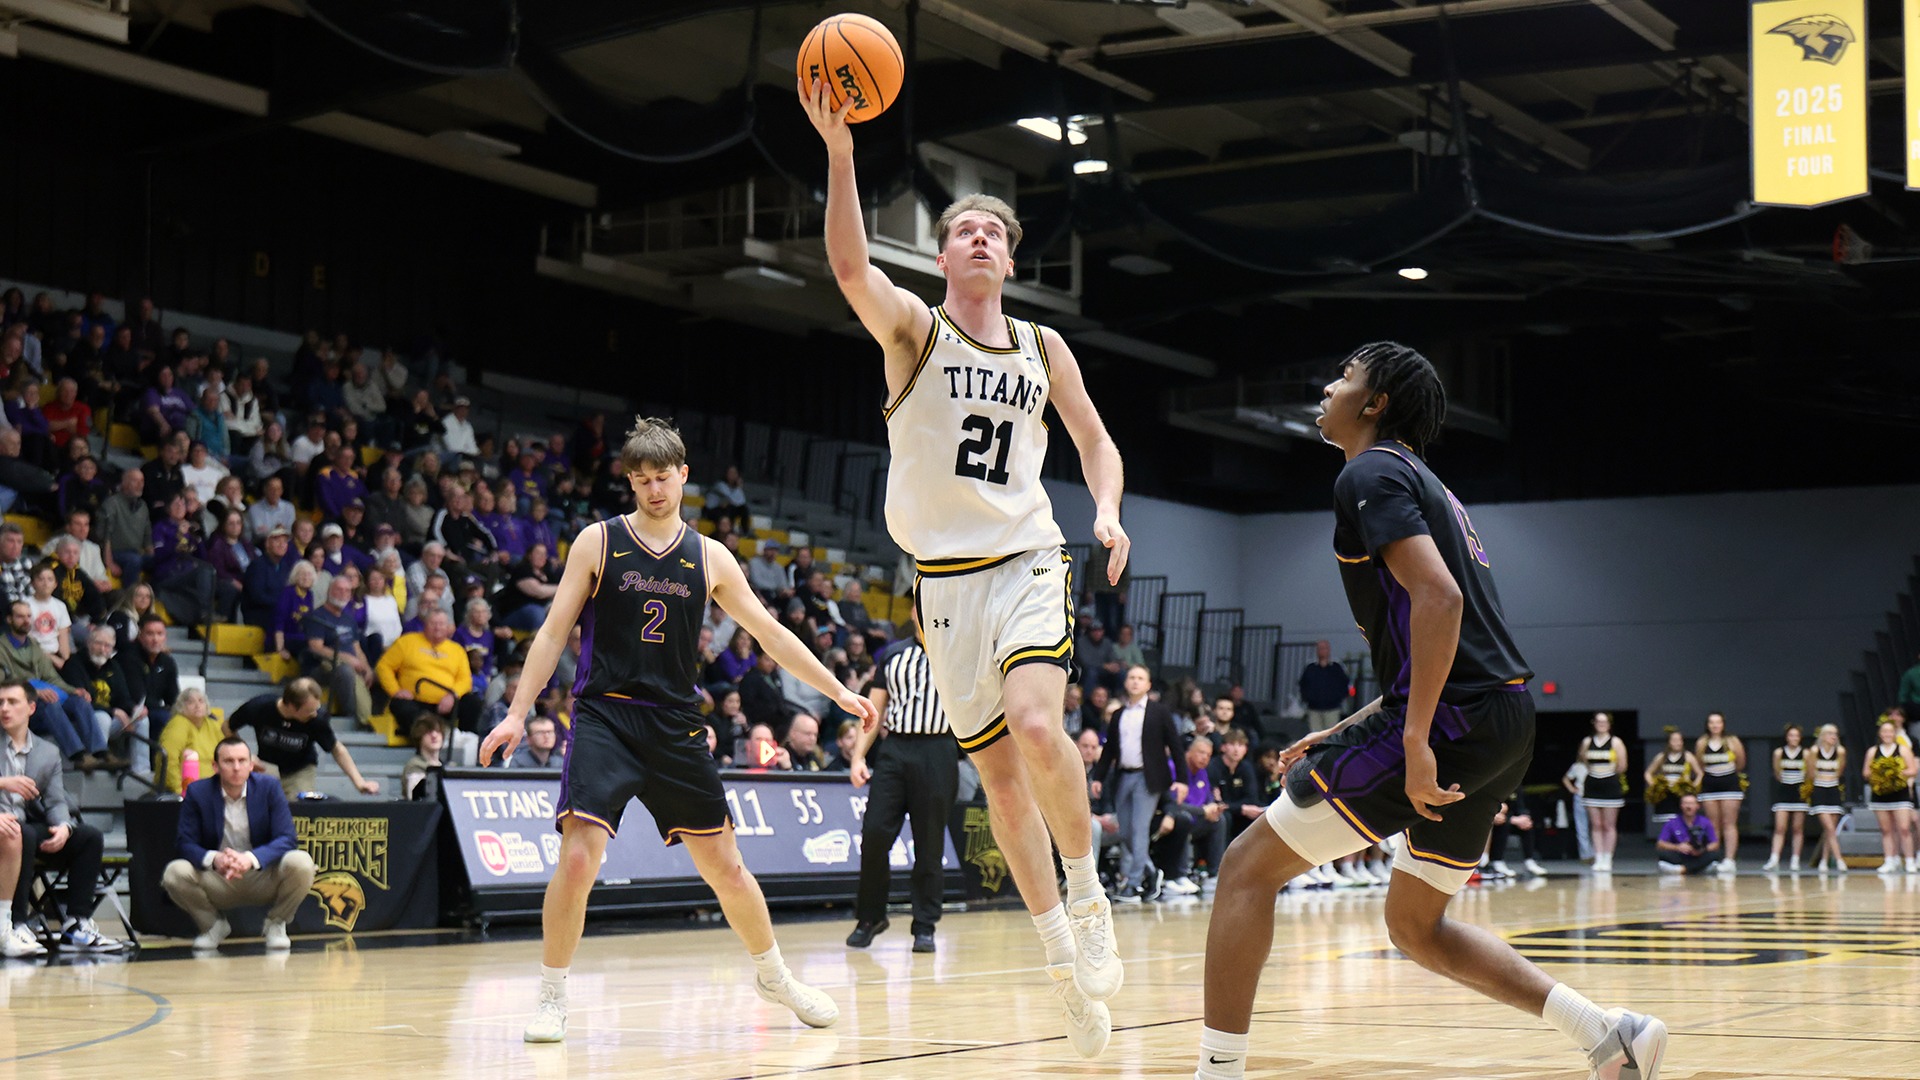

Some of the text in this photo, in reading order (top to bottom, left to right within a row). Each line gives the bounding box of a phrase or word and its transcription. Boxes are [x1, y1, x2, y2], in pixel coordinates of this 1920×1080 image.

[835, 64, 869, 111] NCAA
[1775, 83, 1843, 117] 2025
[1783, 123, 1837, 148] FINAL
[1786, 154, 1834, 178] FOUR
[943, 366, 1042, 415] TITANS
[955, 413, 1014, 485] 21
[619, 570, 692, 598] Pointers
[641, 599, 668, 643] 2
[462, 790, 555, 820] TITANS
[790, 788, 824, 824] 55
[508, 845, 538, 857] credit
[511, 860, 541, 870] union
